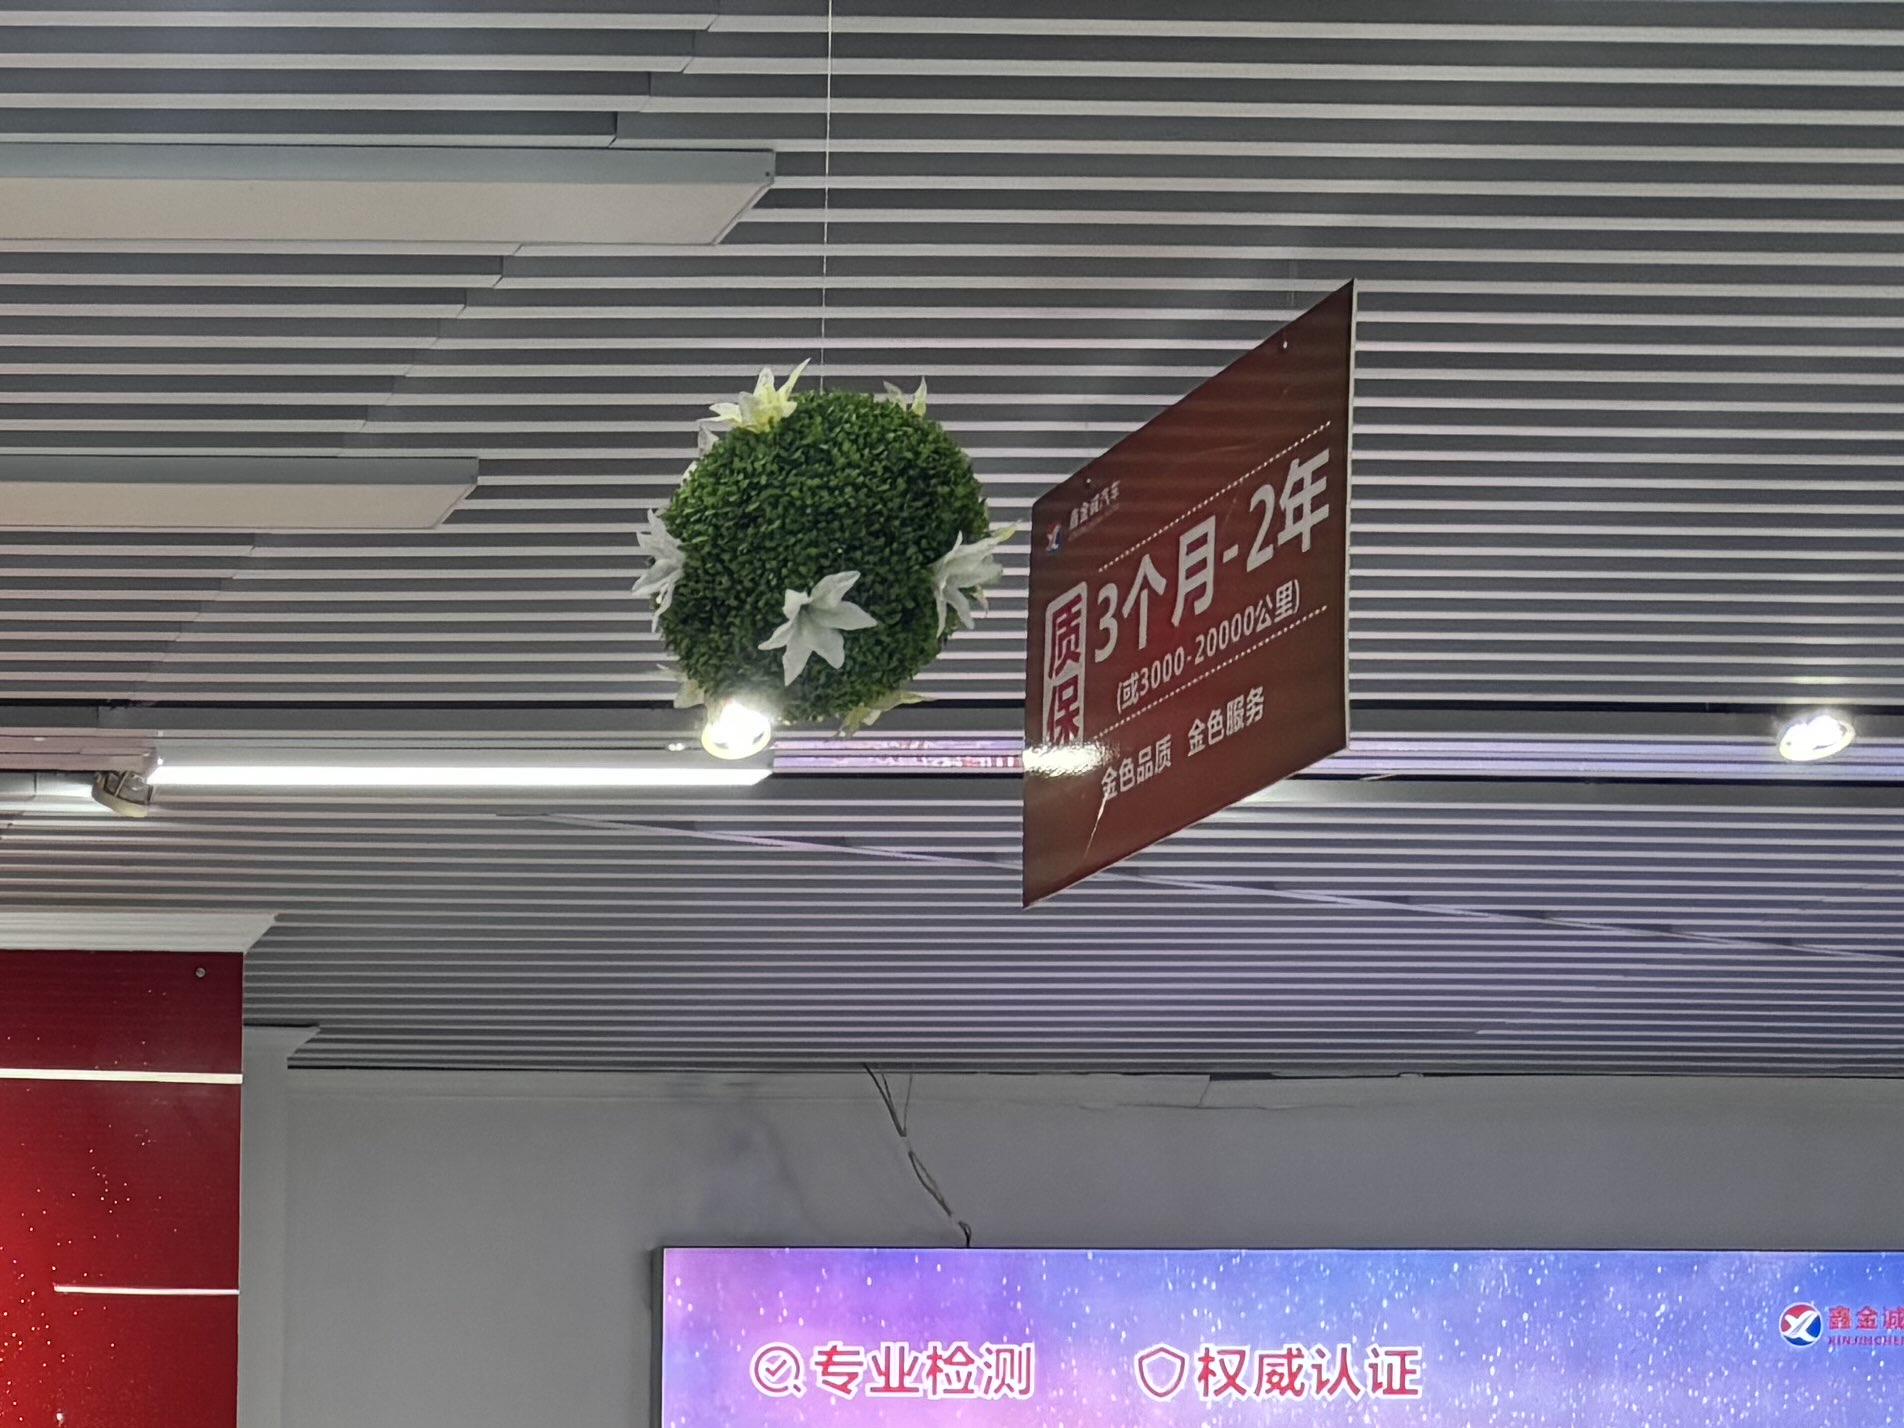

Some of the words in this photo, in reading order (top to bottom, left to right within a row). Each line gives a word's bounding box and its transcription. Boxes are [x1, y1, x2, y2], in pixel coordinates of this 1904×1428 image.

[1094, 448, 1330, 664] 3个月-2年
[1048, 594, 1082, 746] 质保
[1116, 579, 1300, 713] (或3000-20000公里)
[1101, 734, 1172, 801] 金色品质
[1187, 686, 1265, 757] 金色服务
[814, 1344, 1033, 1397] 专业检测
[1197, 1346, 1423, 1398] 权威认证
